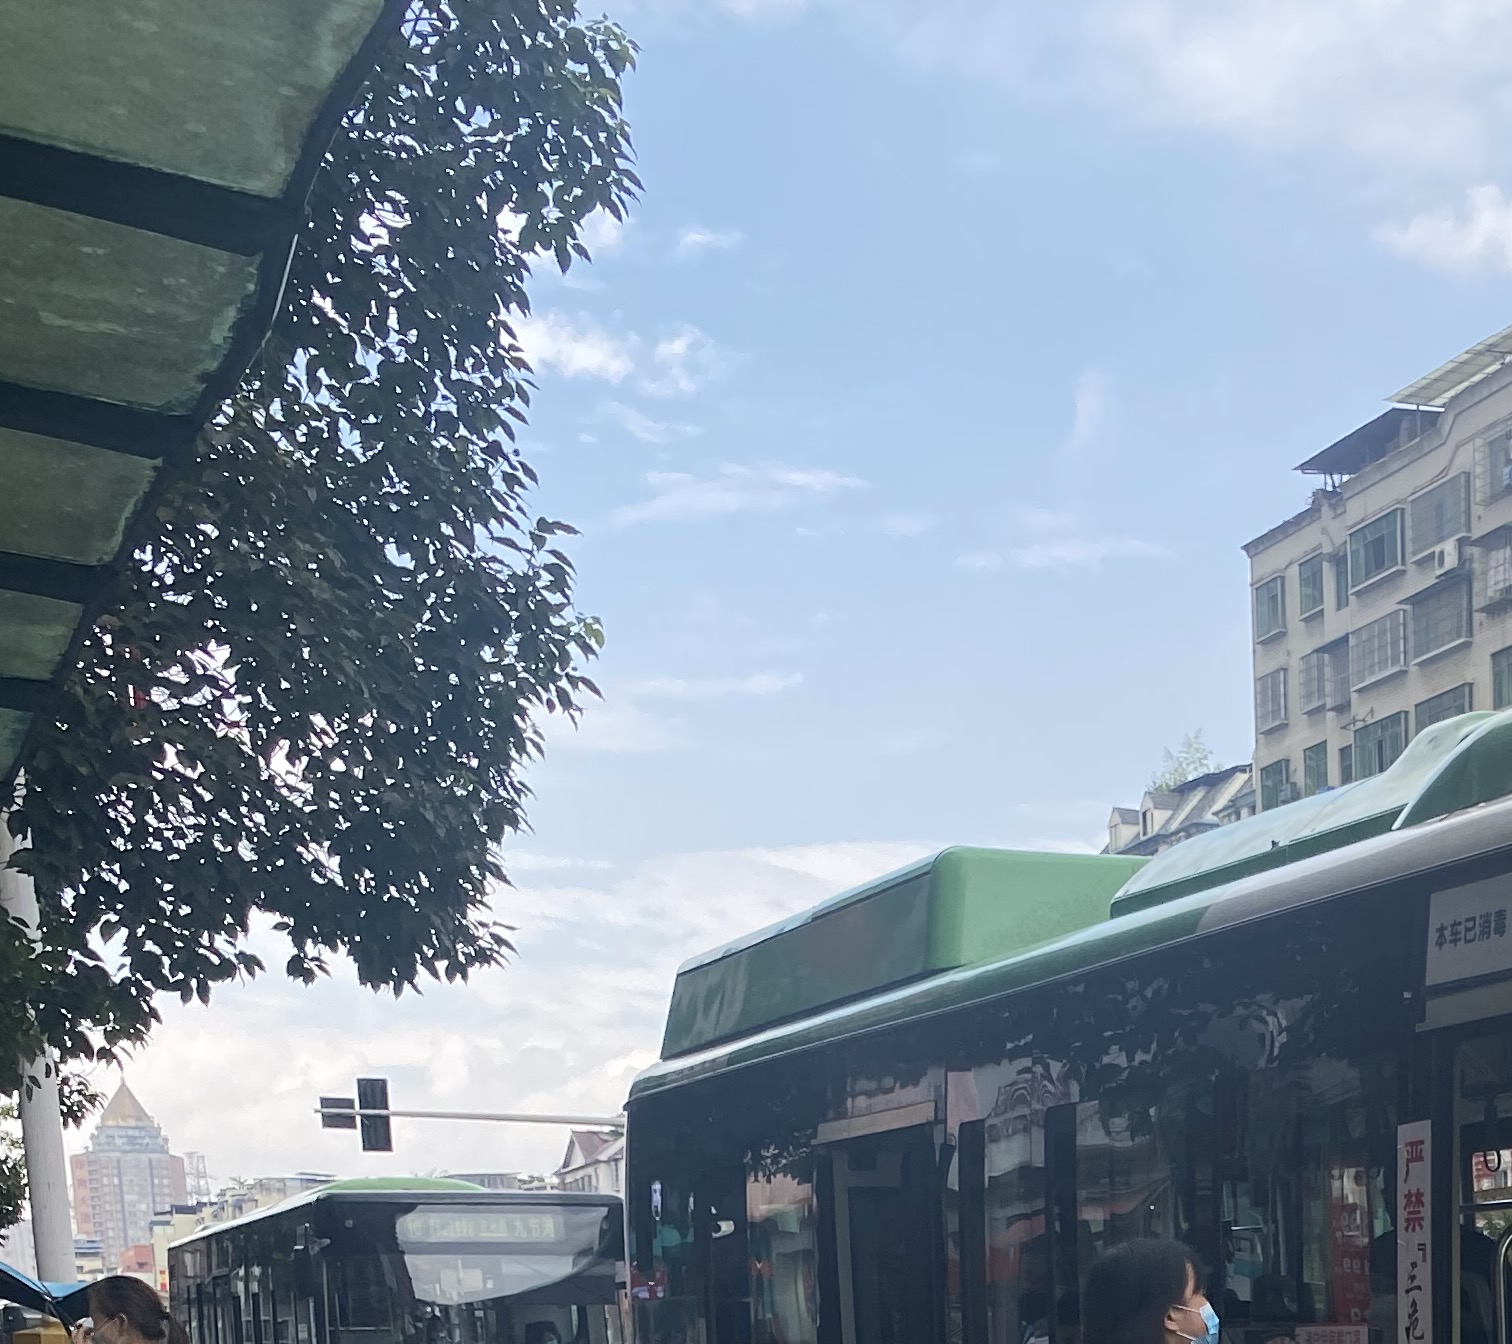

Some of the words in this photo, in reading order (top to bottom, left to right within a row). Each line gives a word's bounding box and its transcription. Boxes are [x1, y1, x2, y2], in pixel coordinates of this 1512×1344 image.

[1434, 908, 1507, 952] 本车已消毒
